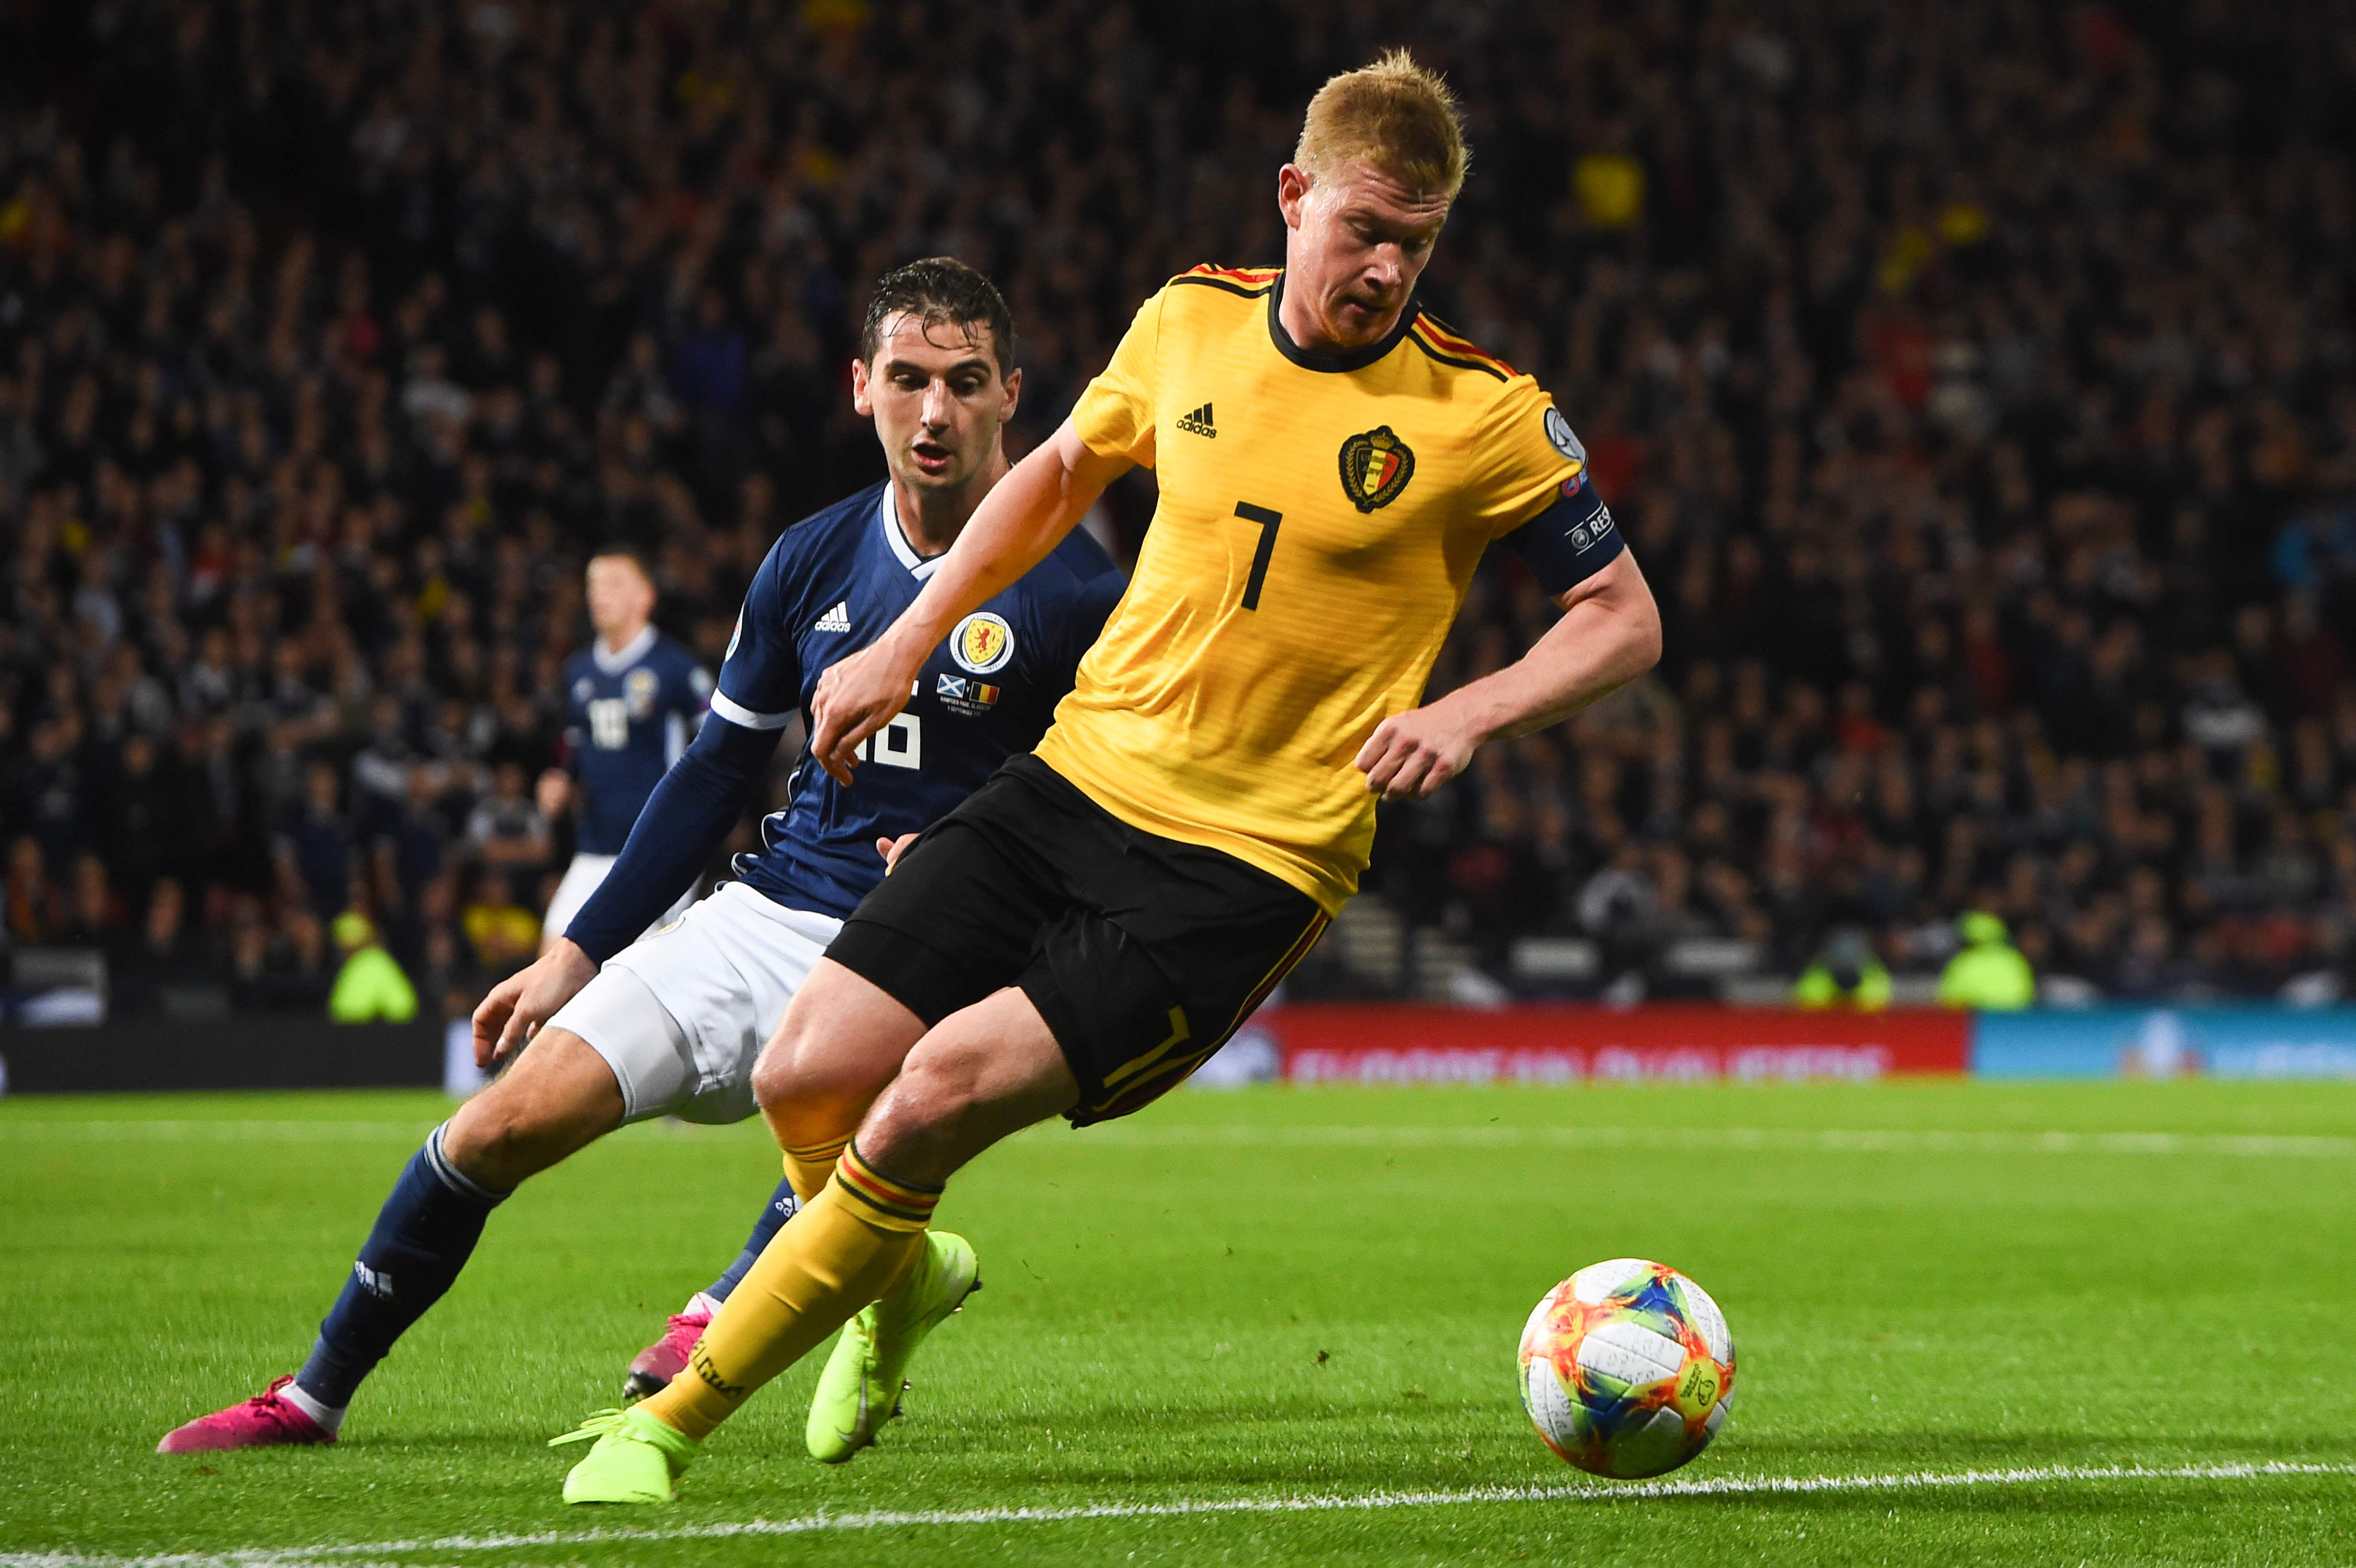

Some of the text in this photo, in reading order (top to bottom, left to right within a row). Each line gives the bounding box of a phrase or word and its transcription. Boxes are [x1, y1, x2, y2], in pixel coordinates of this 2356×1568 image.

[1176, 419, 1217, 439] adidas
[1234, 501, 1283, 611] 7
[814, 620, 851, 633] adidas
[854, 679, 921, 771] 6
[1102, 1004, 1190, 1089] 7
